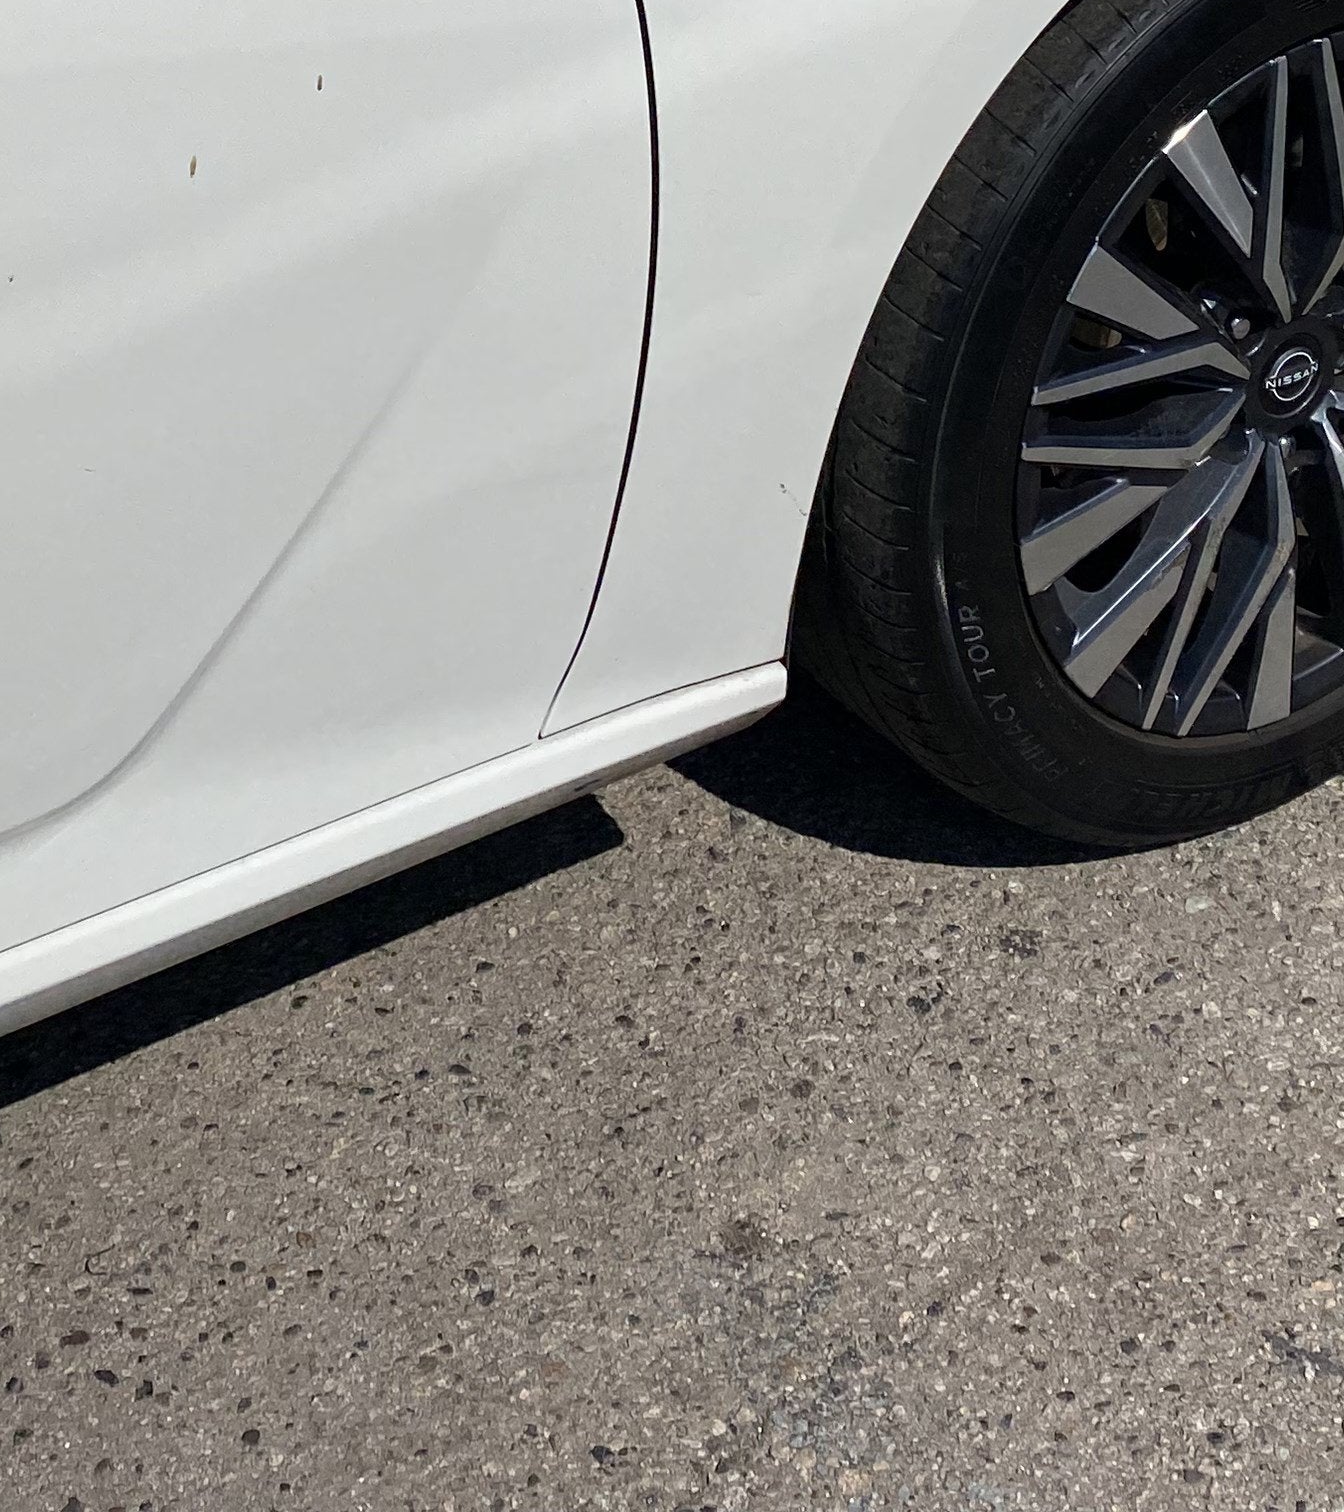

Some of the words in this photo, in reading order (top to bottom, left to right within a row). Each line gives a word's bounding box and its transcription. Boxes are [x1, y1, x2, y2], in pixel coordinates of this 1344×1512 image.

[1265, 360, 1319, 389] NISSAN
[959, 603, 997, 684] TOUR
[982, 691, 1069, 783] PRIMACY
